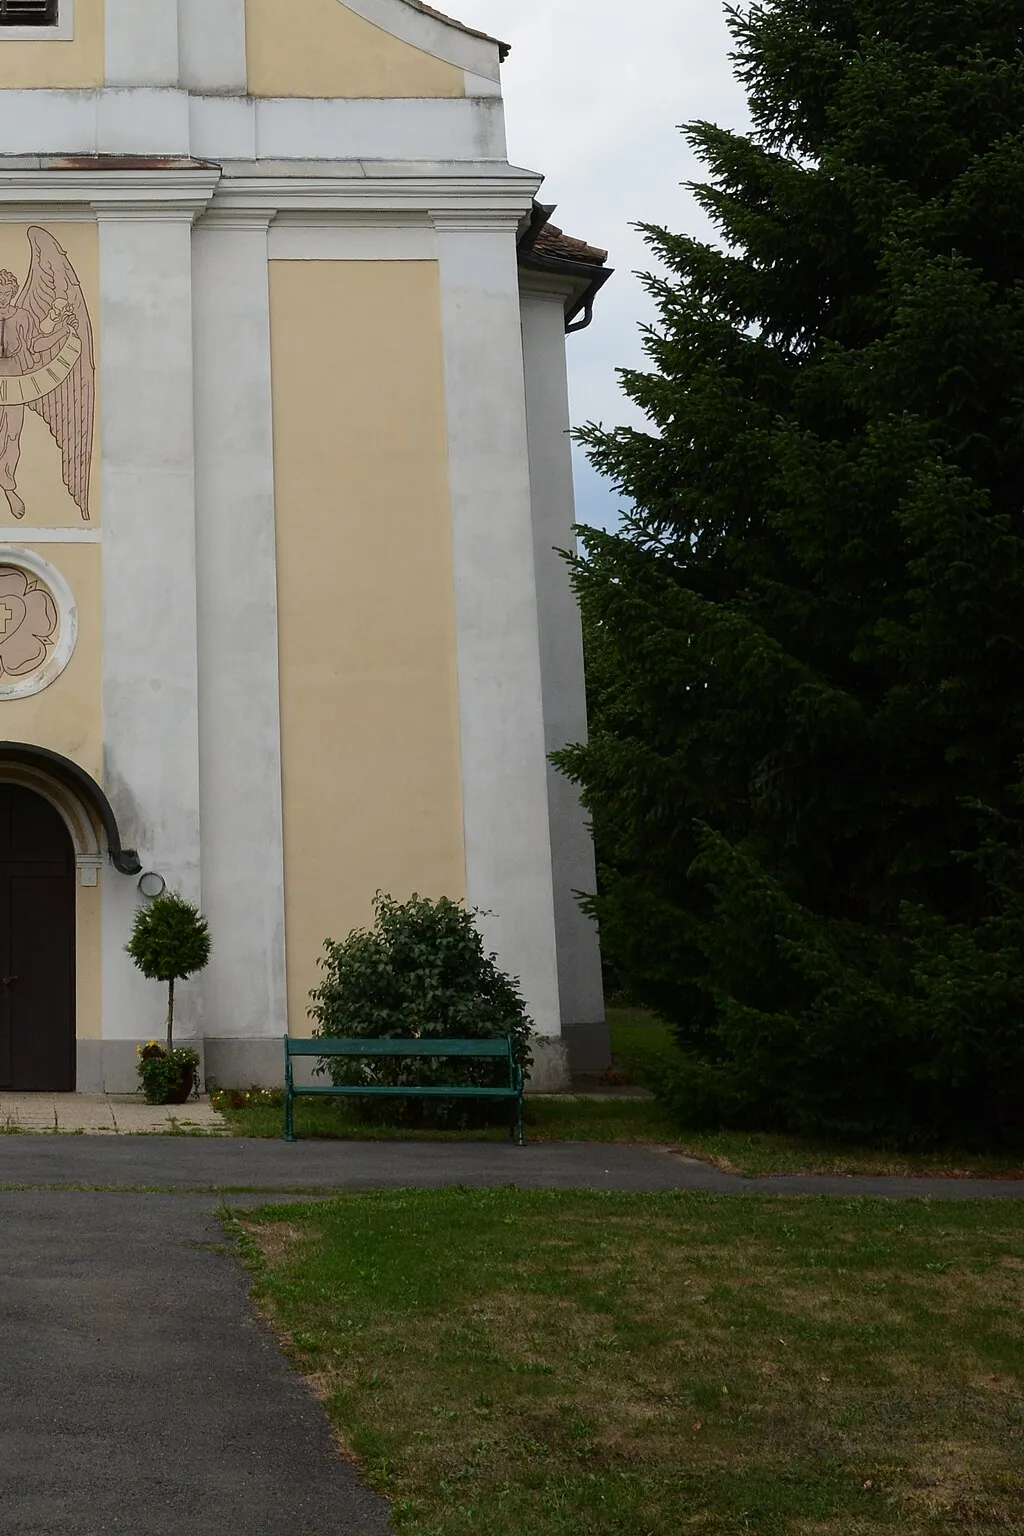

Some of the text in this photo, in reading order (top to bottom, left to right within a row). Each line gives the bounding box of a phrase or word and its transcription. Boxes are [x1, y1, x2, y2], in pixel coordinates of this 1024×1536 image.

[19, 380, 24, 400] I
[31, 377, 41, 394] II
[46, 368, 60, 383] III
[57, 356, 70, 369] IV
